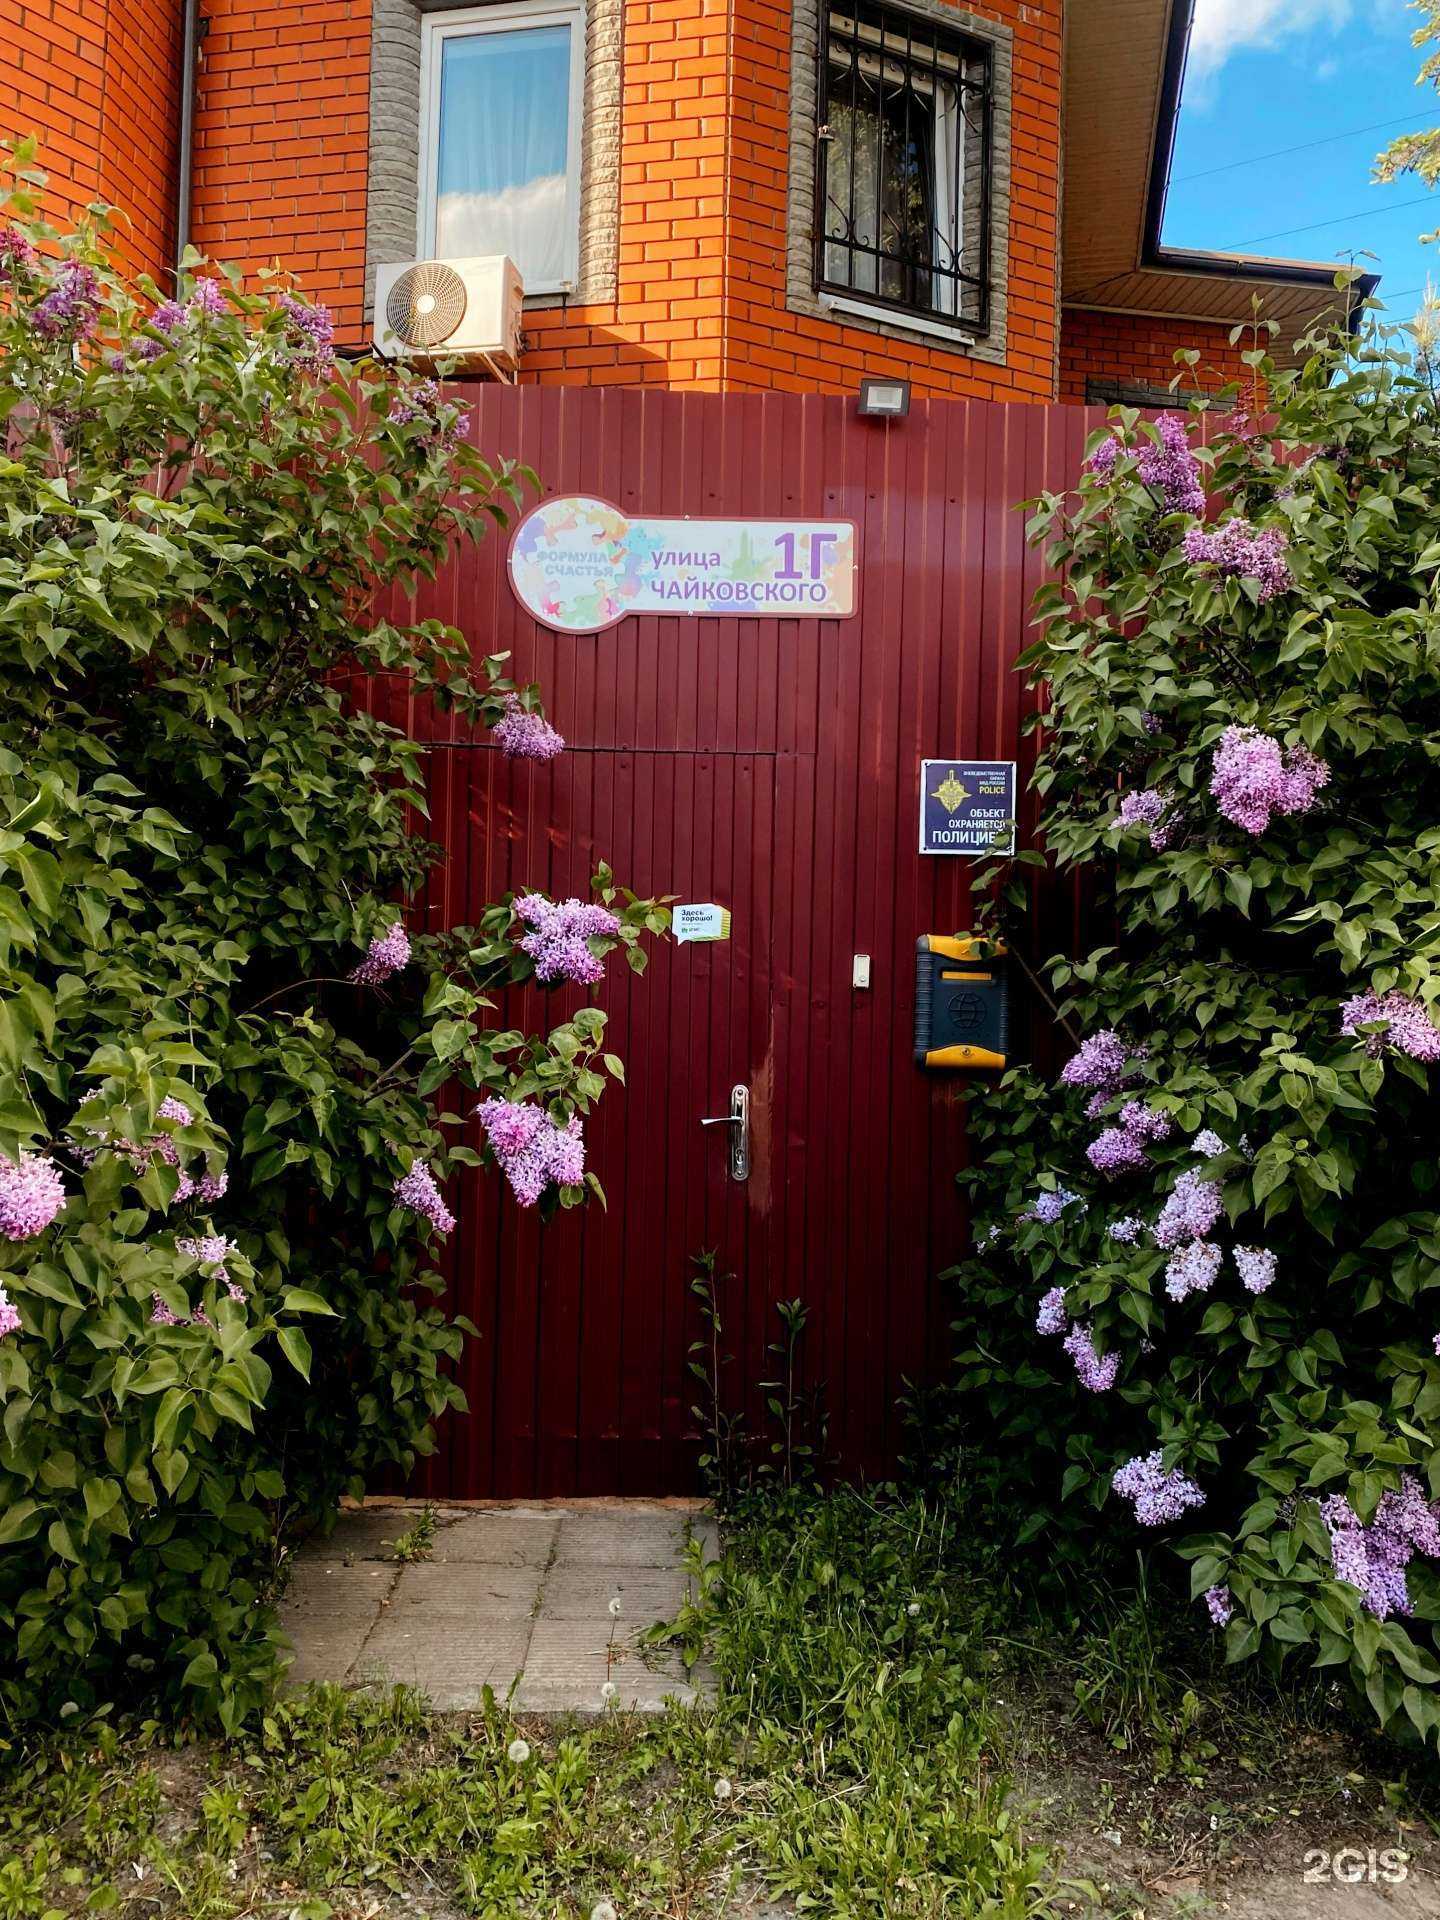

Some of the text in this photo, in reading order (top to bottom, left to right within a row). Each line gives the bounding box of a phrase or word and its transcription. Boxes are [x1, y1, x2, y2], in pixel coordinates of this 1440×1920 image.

[536, 551, 608, 563] ФОРМУЛА
[651, 551, 721, 570] улица
[773, 532, 838, 580] 1Г
[544, 564, 614, 577] СЧАСТЬЯ
[651, 577, 827, 602] ЧАЙКОВСКОГО
[979, 786, 1006, 794] POLICE
[970, 808, 1006, 818] ОБЪЕКТ
[932, 830, 1002, 845] ПОЛИЦИЕ
